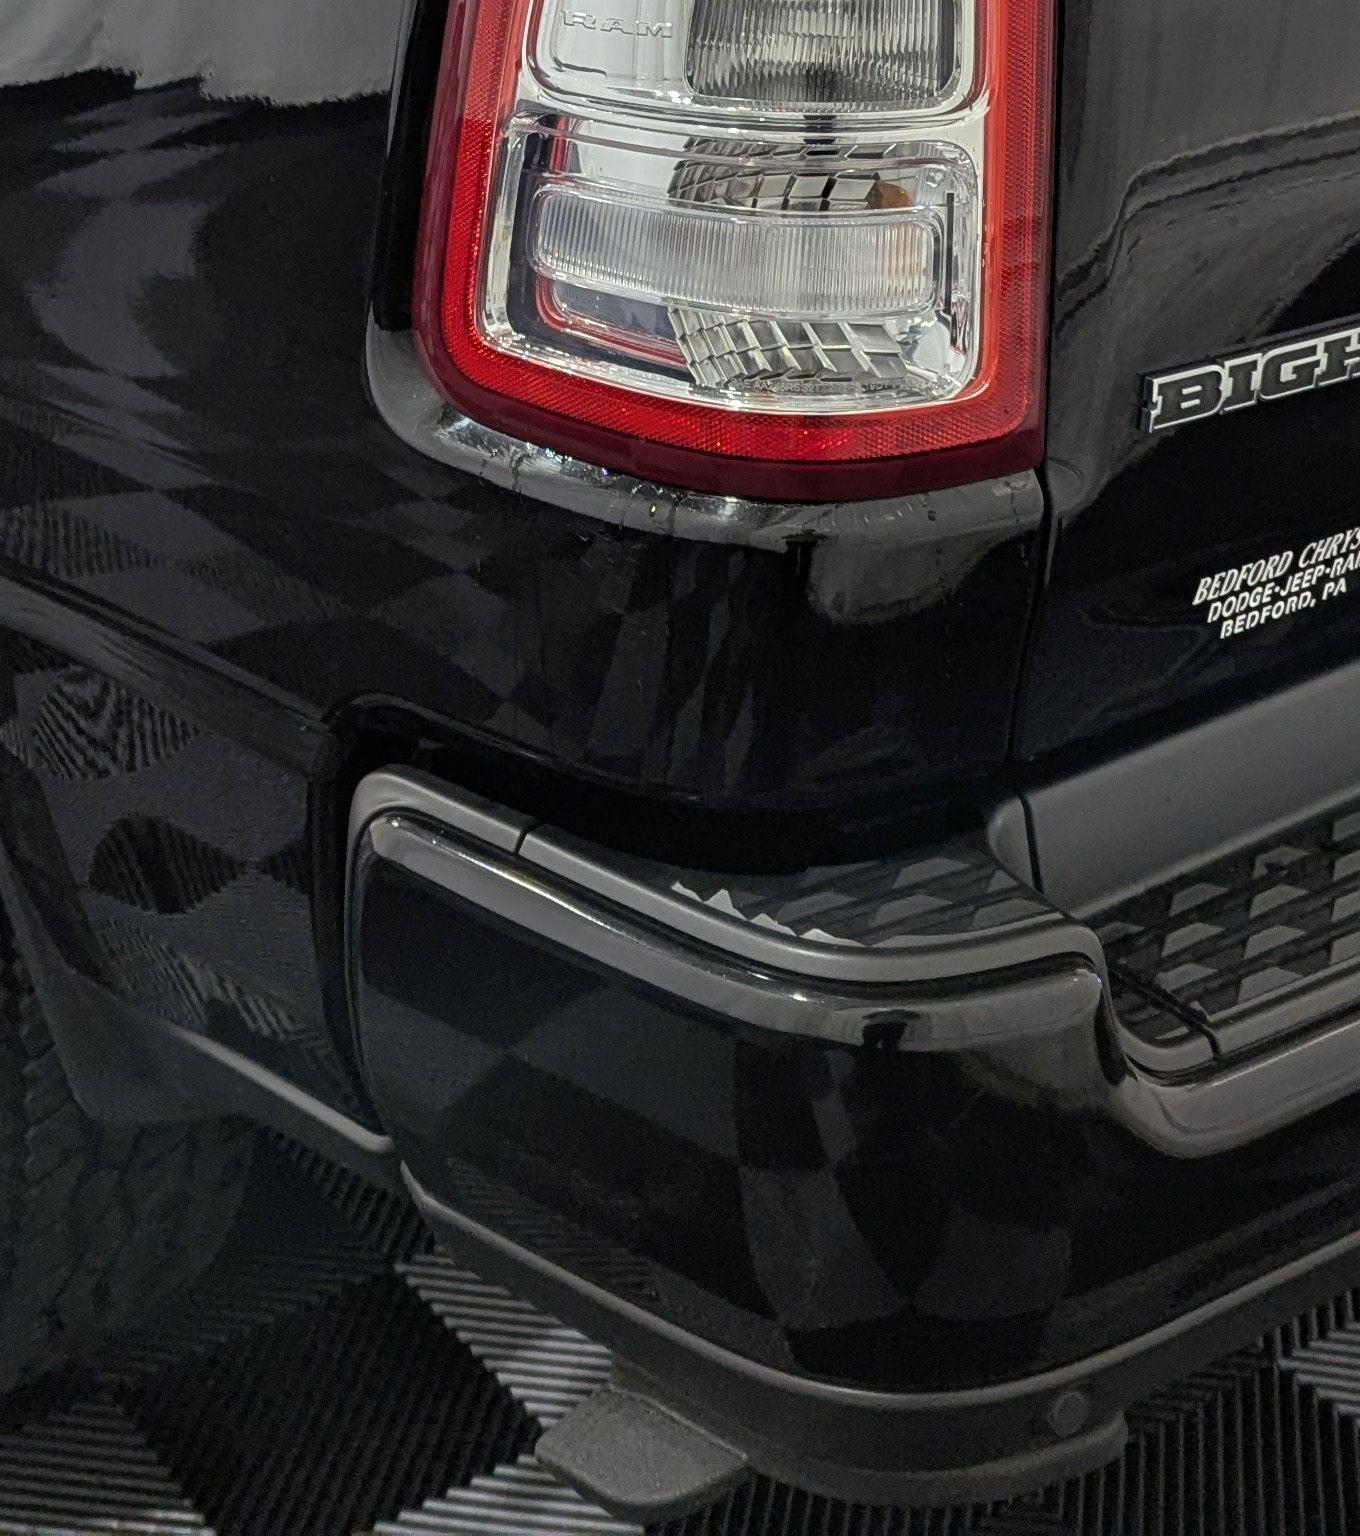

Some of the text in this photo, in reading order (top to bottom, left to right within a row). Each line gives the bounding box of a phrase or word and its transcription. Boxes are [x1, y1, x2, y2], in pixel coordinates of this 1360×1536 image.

[559, 9, 674, 39] RAM
[1191, 550, 1295, 606] BEDFORD
[1219, 577, 1348, 640] BEDFORD, PA
